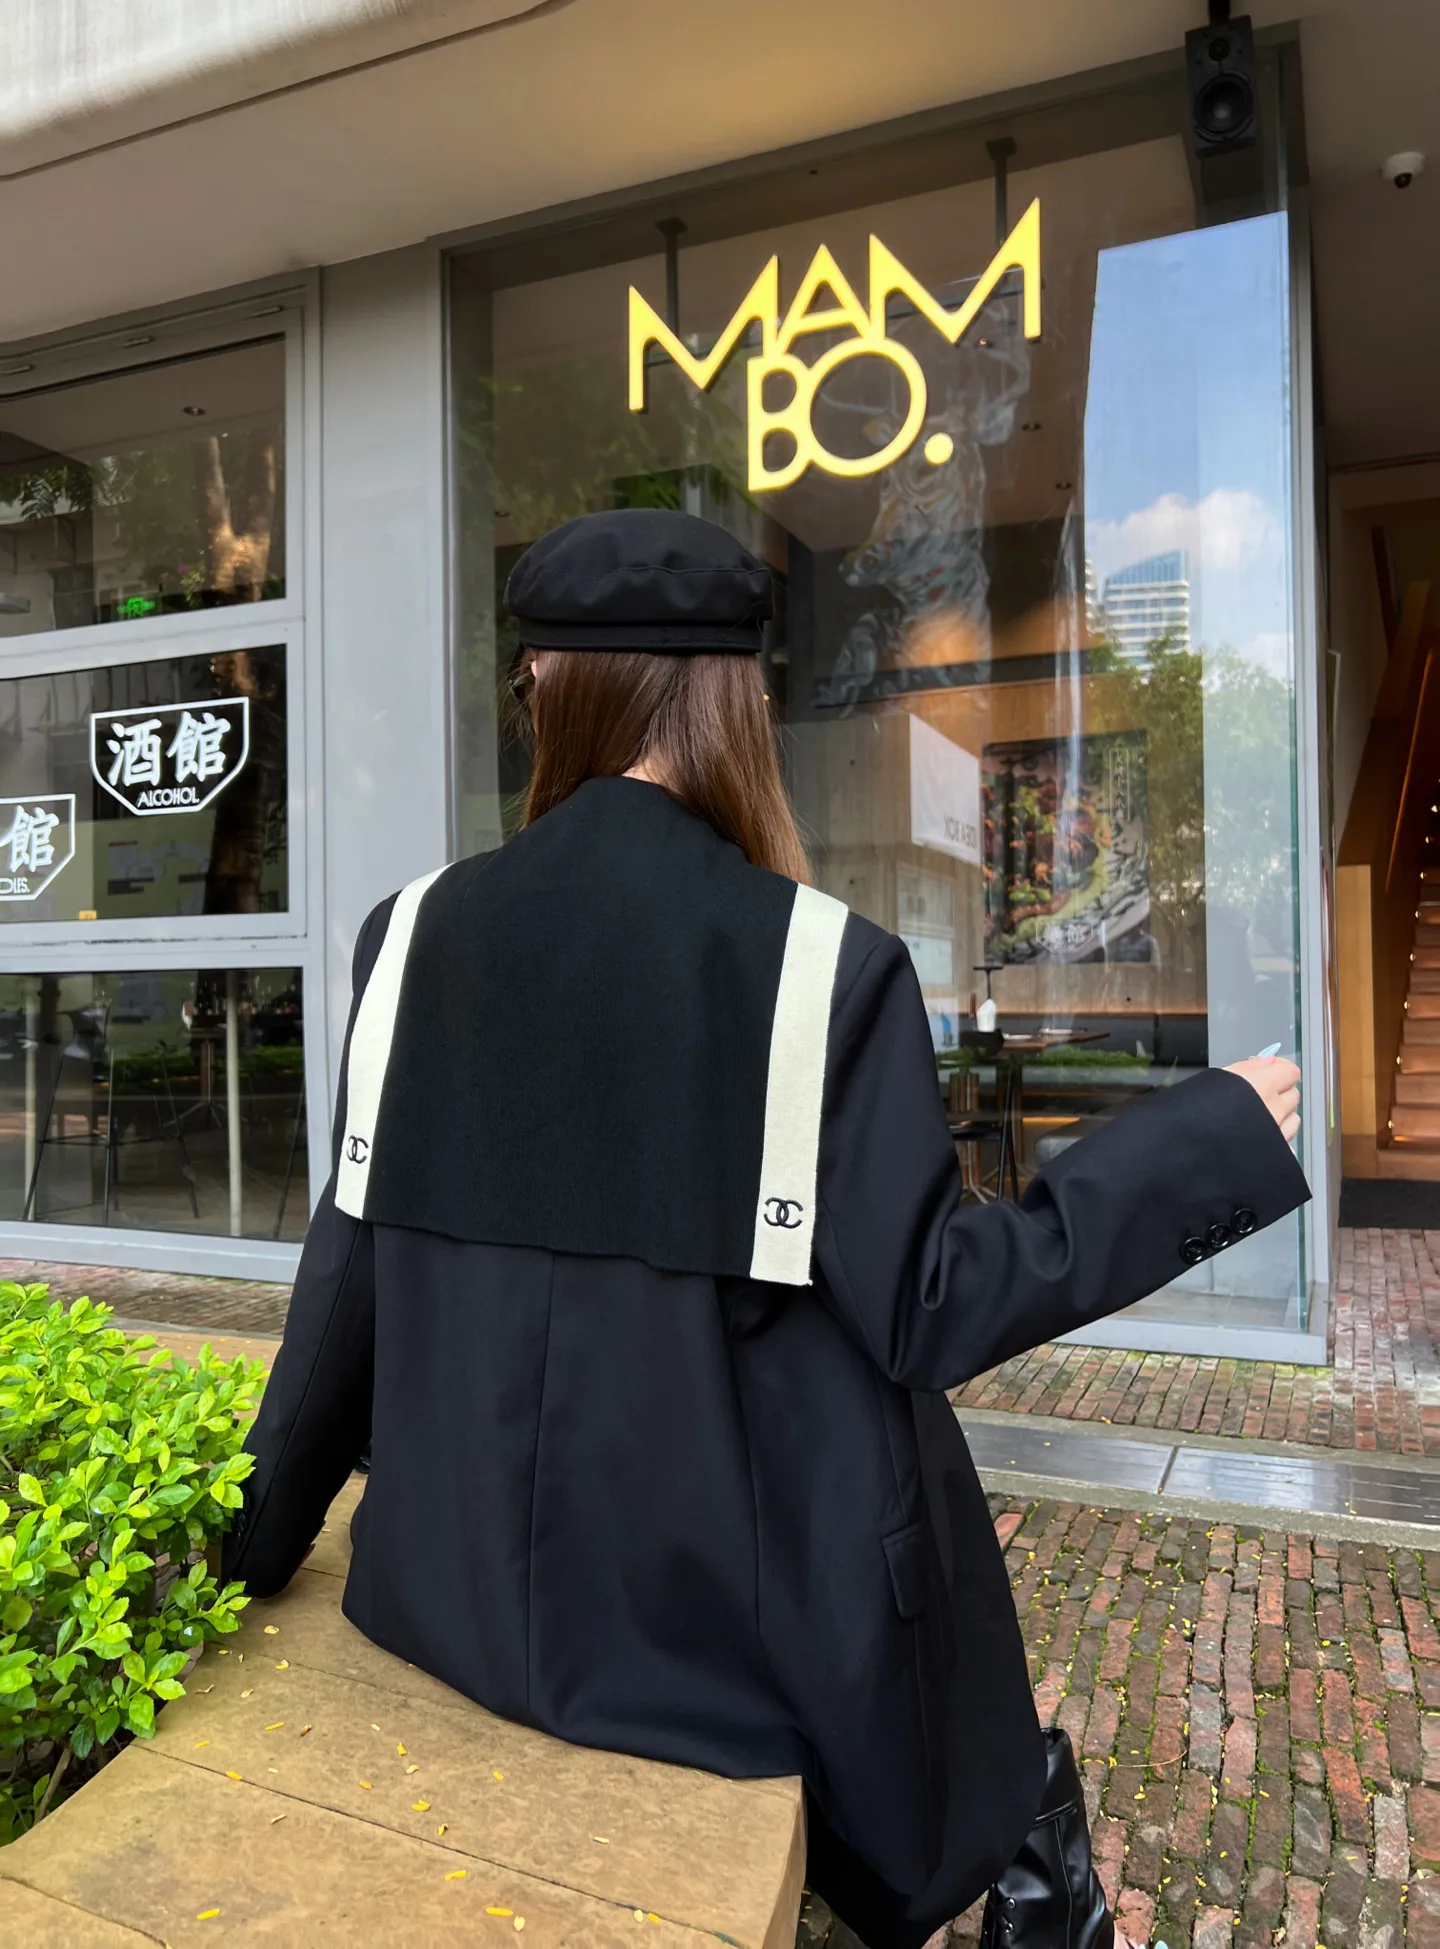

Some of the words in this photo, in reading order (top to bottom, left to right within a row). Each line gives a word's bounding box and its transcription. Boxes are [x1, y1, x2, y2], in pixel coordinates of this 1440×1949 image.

[629, 198, 1042, 411] MAM
[106, 711, 231, 787] 酒館
[136, 786, 200, 808] ALCOHOL.
[0, 805, 60, 873] 館
